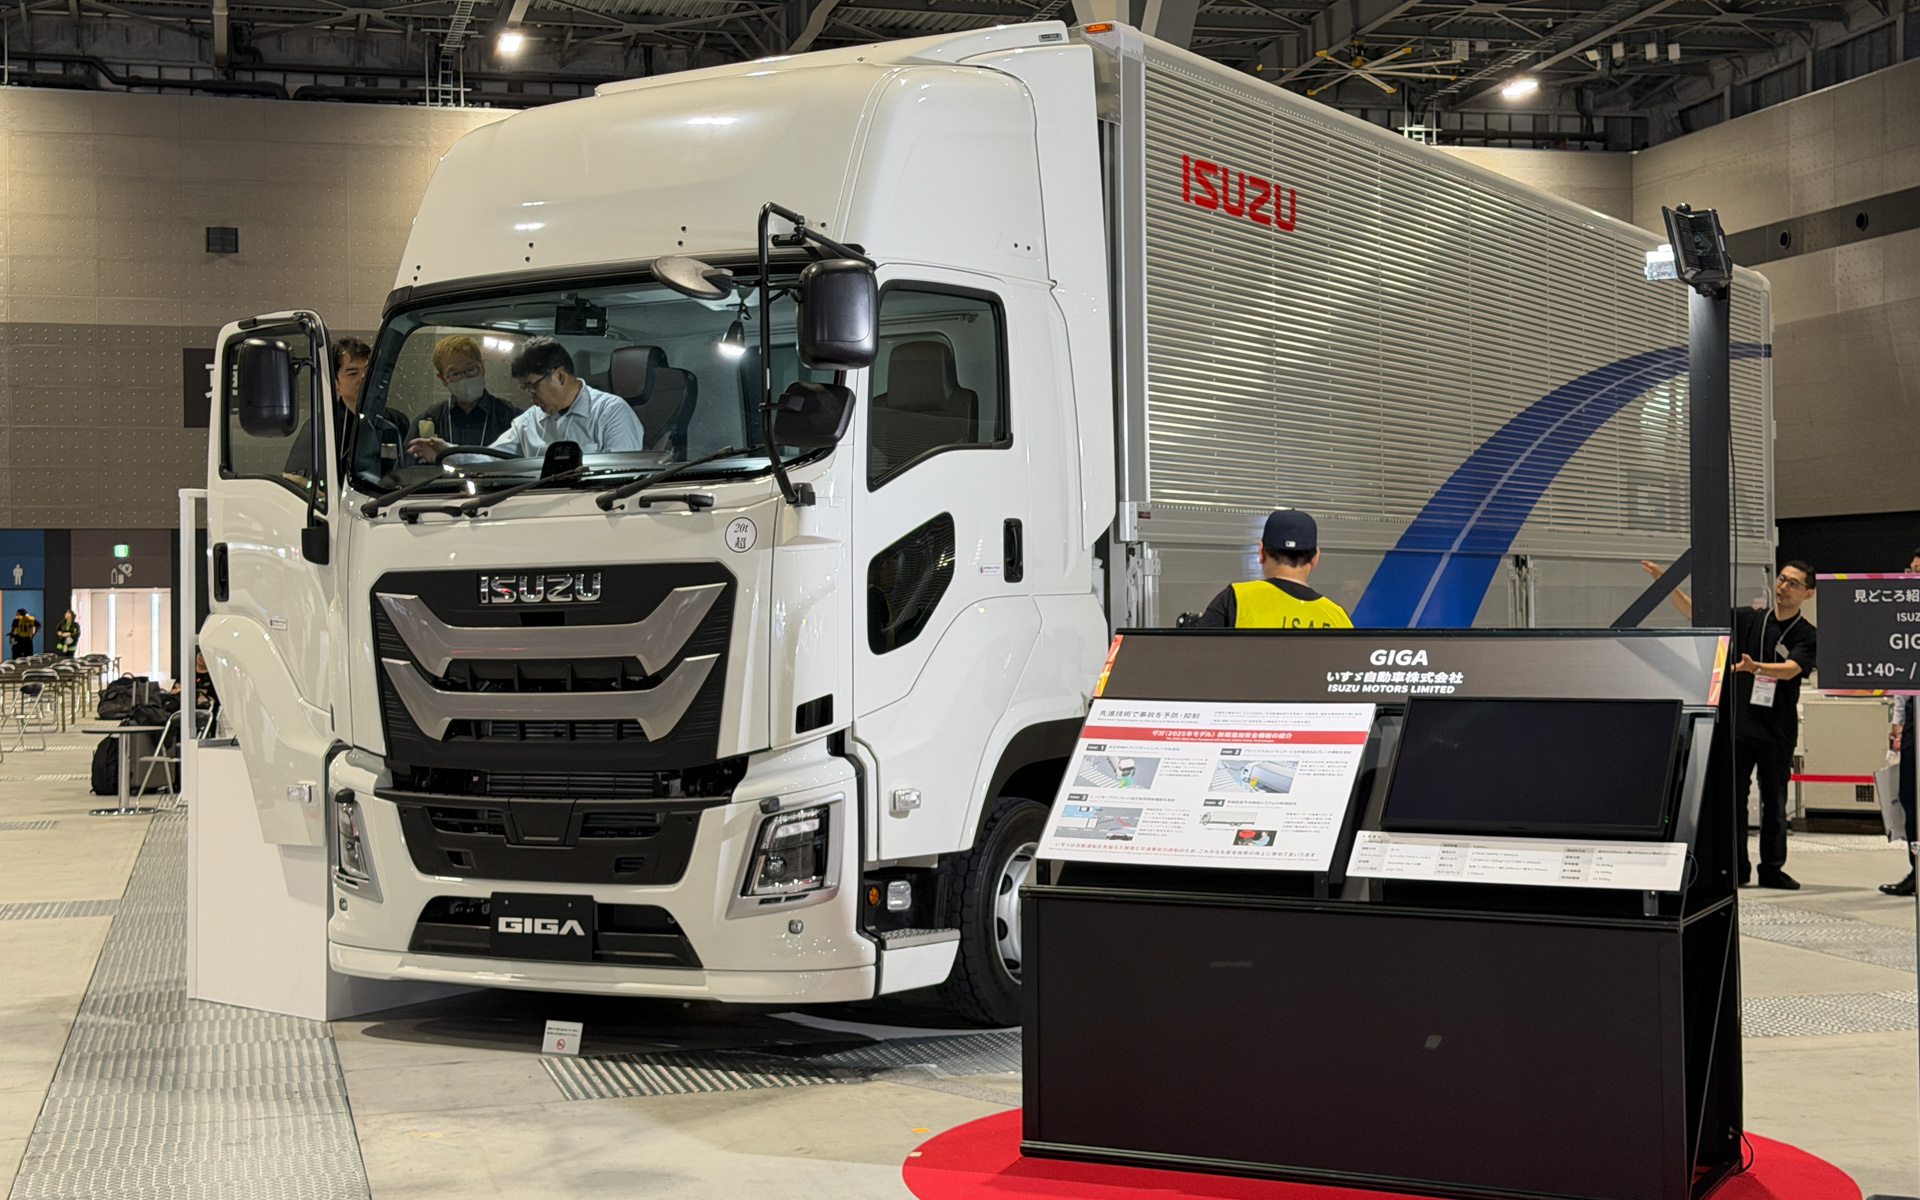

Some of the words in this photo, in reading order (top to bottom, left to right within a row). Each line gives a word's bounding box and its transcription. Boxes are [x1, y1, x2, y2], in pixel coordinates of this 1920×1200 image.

[1182, 154, 1296, 232] ISUZU
[734, 523, 749, 533] 20t
[735, 536, 747, 549] 超
[480, 572, 602, 604] ISUZU
[1370, 649, 1429, 666] GIGA
[1326, 671, 1464, 684] いすゞ自動車株式会社
[1327, 684, 1359, 693] ISUZU
[1362, 684, 1408, 694] MOTORS
[1410, 685, 1455, 694] LIMITED
[1099, 709, 1201, 720] 先進技術で事故を予防・抑制
[498, 917, 585, 936] GIGA
